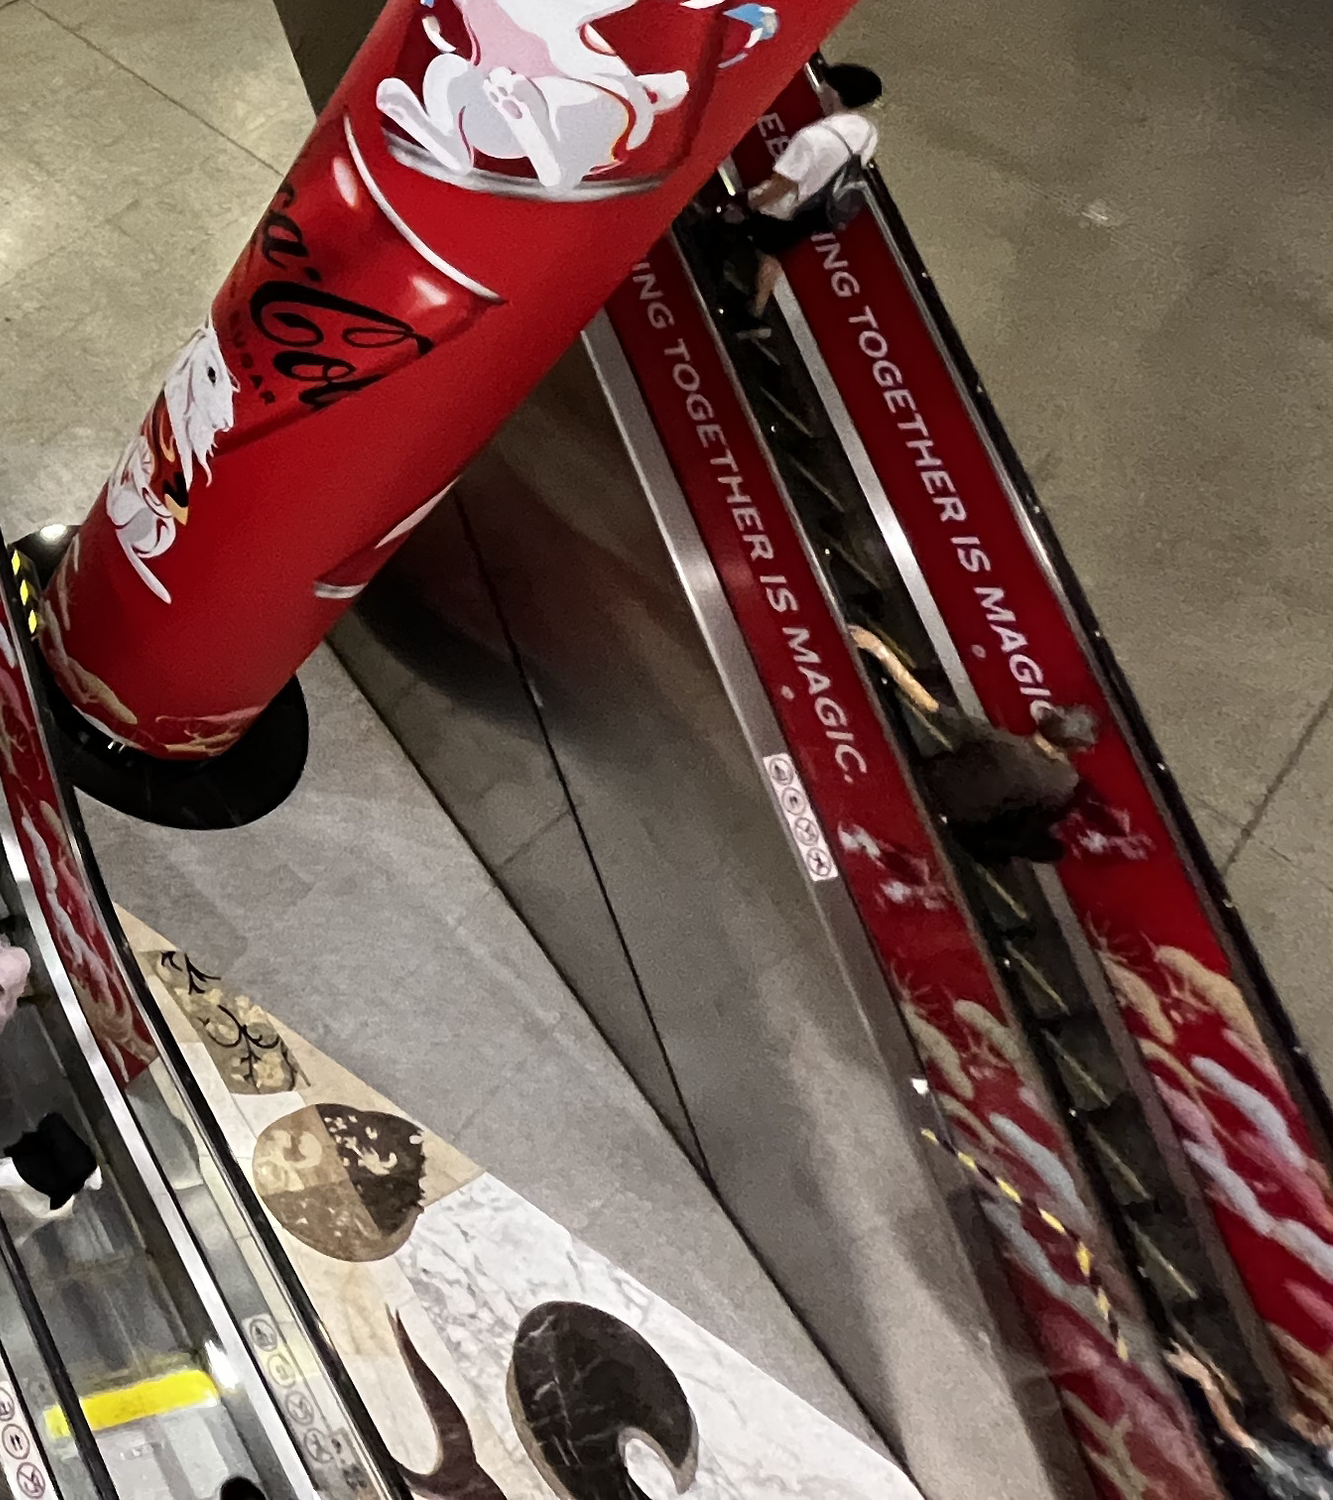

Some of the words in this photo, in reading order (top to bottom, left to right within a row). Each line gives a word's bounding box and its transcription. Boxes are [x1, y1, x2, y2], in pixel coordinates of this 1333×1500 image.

[664, 338, 775, 562] TOGETHER
[759, 575, 799, 613] IS
[782, 627, 868, 784] MAGIC.
[848, 305, 968, 523] TOGETHER
[949, 536, 993, 573] IS
